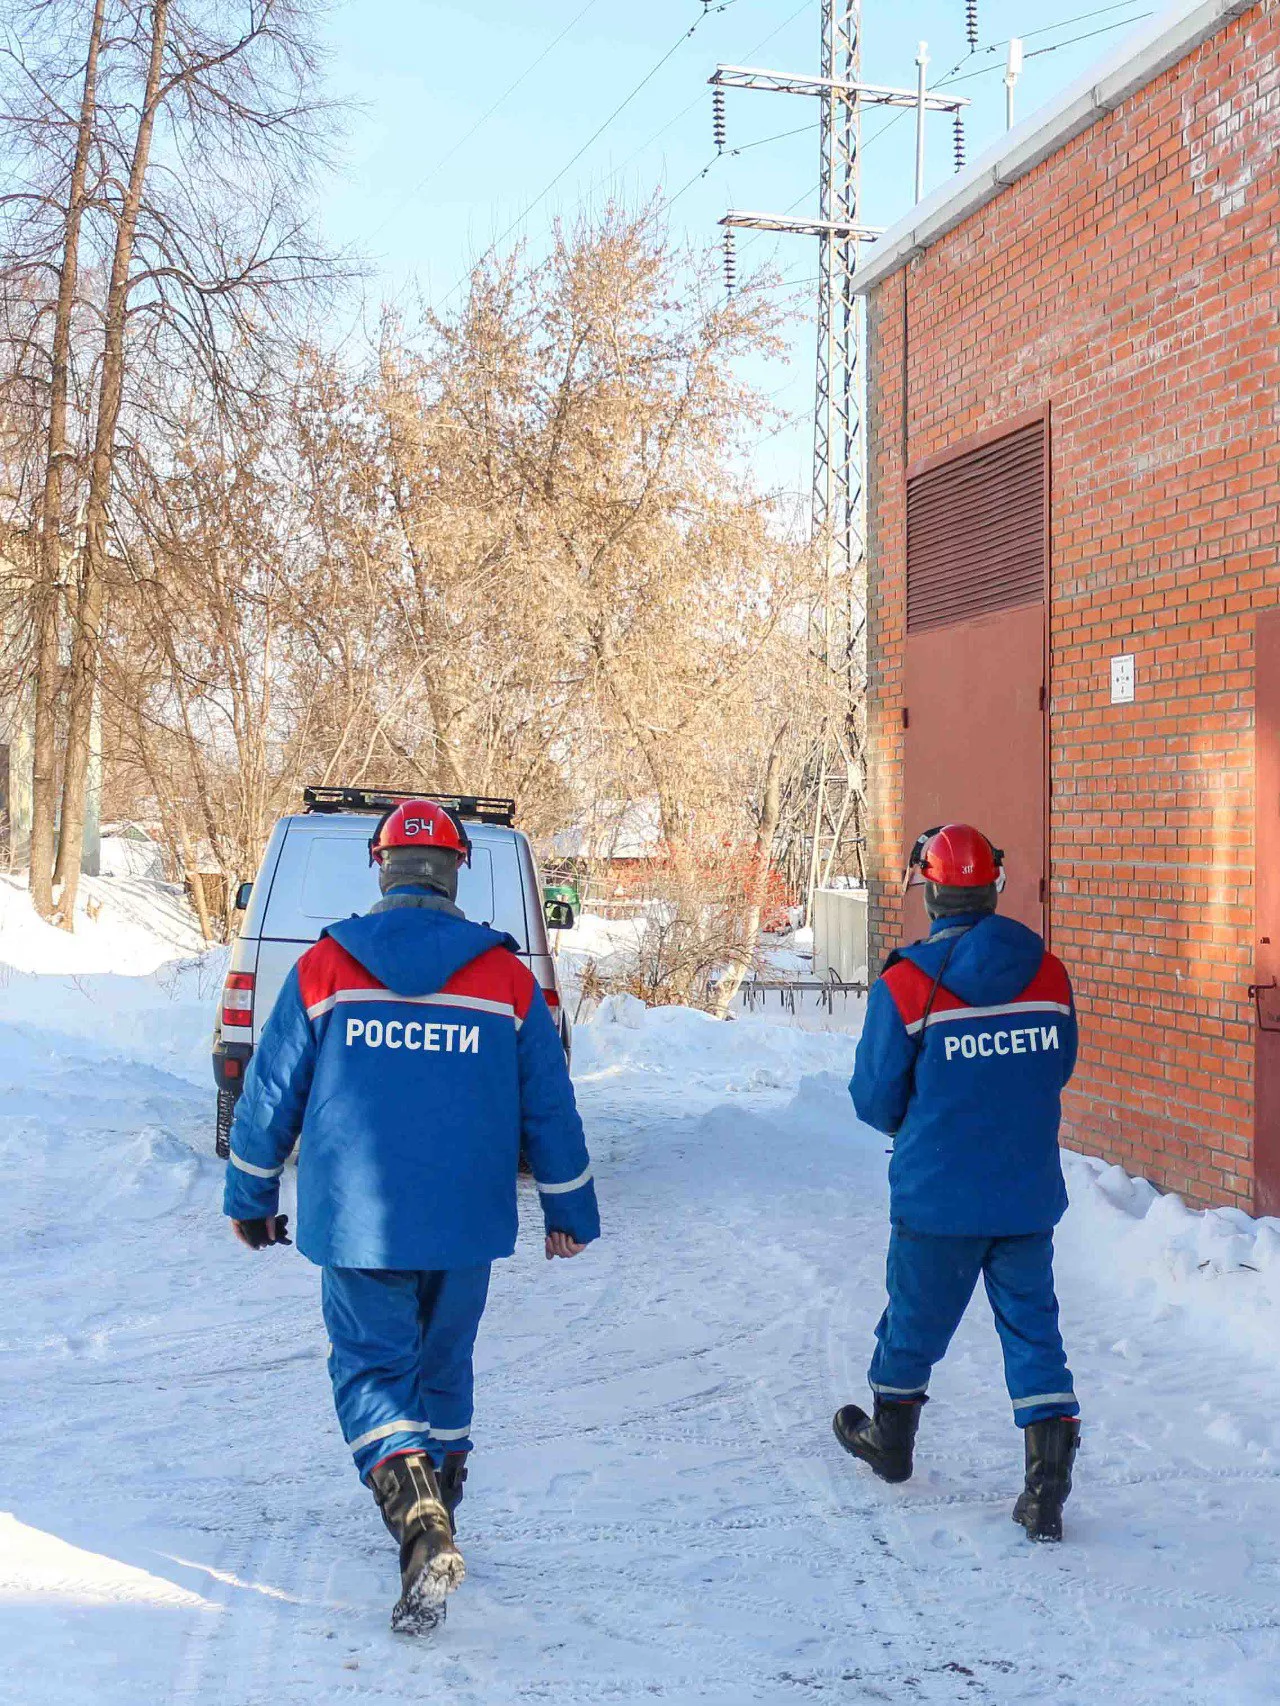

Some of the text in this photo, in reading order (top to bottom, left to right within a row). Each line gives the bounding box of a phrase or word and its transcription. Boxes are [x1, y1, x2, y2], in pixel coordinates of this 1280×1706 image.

[404, 817, 434, 837] 54
[345, 1018, 480, 1054] РОССЕТИ
[943, 1025, 1060, 1061] РОССЕТИ
